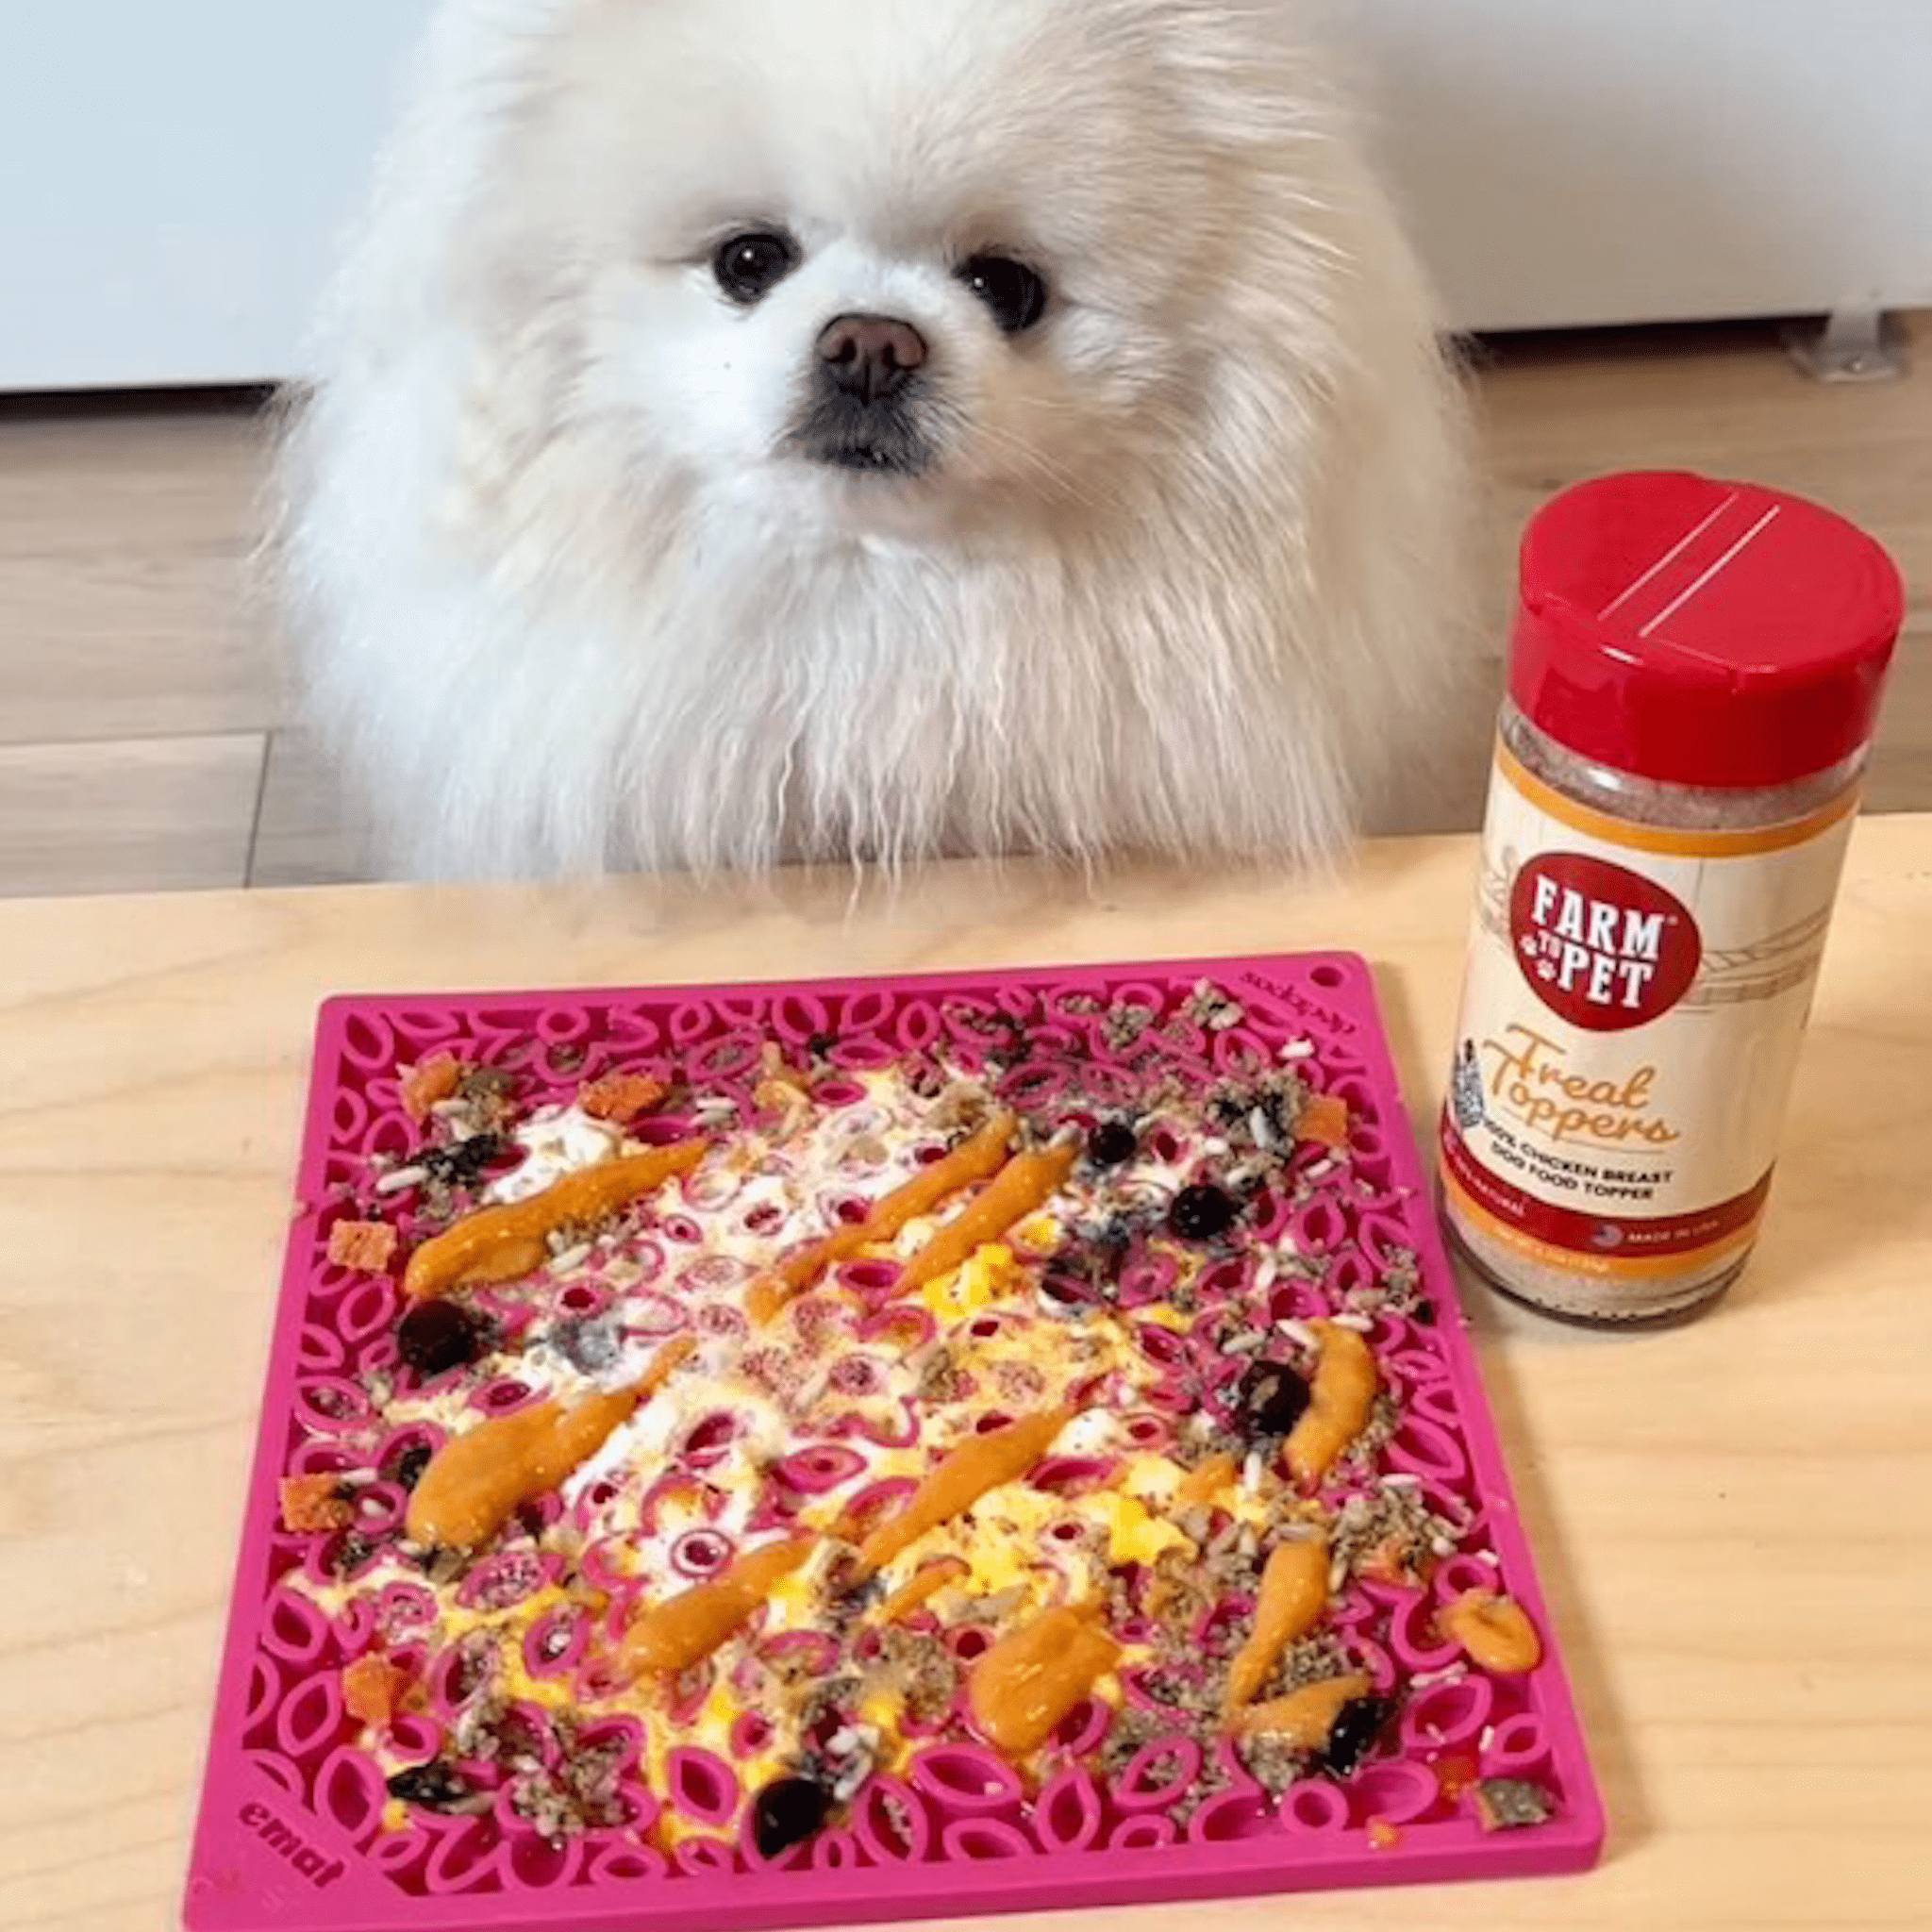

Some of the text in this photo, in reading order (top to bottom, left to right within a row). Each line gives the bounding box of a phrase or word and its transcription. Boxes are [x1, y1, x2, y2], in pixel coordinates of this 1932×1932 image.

[1530, 873, 1665, 961] FARM
[1557, 941, 1655, 1008] PET
[1482, 1040, 1681, 1142] Toppers
[1506, 1023, 1656, 1108] Treat
[1491, 1140, 1526, 1170] DOG
[1529, 1163, 1578, 1190] FOOD
[1584, 1181, 1653, 1200] TOPPER
[1520, 1142, 1598, 1177] CHICKEN
[1602, 1169, 1674, 1184] BREAST
[239, 1802, 345, 1889] emat
